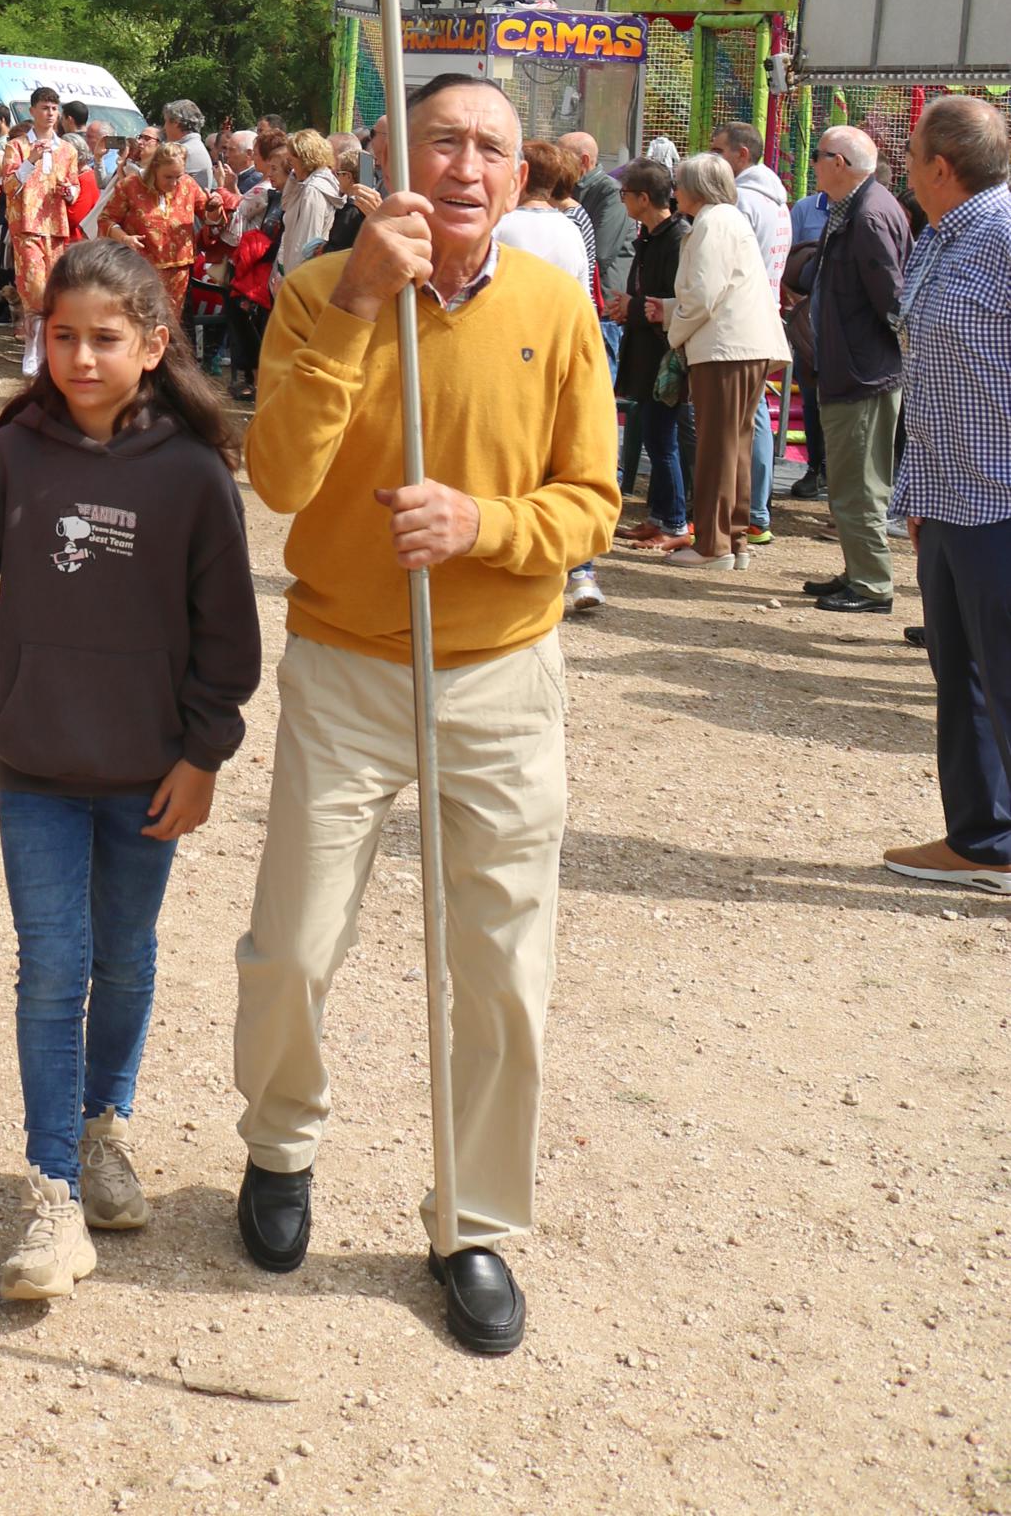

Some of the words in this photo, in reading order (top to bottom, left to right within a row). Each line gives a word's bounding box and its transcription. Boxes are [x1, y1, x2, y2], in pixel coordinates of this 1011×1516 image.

[401, 18, 486, 51] AQUILLA
[496, 19, 643, 58] CAMAS
[75, 503, 137, 529] PEANUTS
[110, 537, 134, 549] Team
